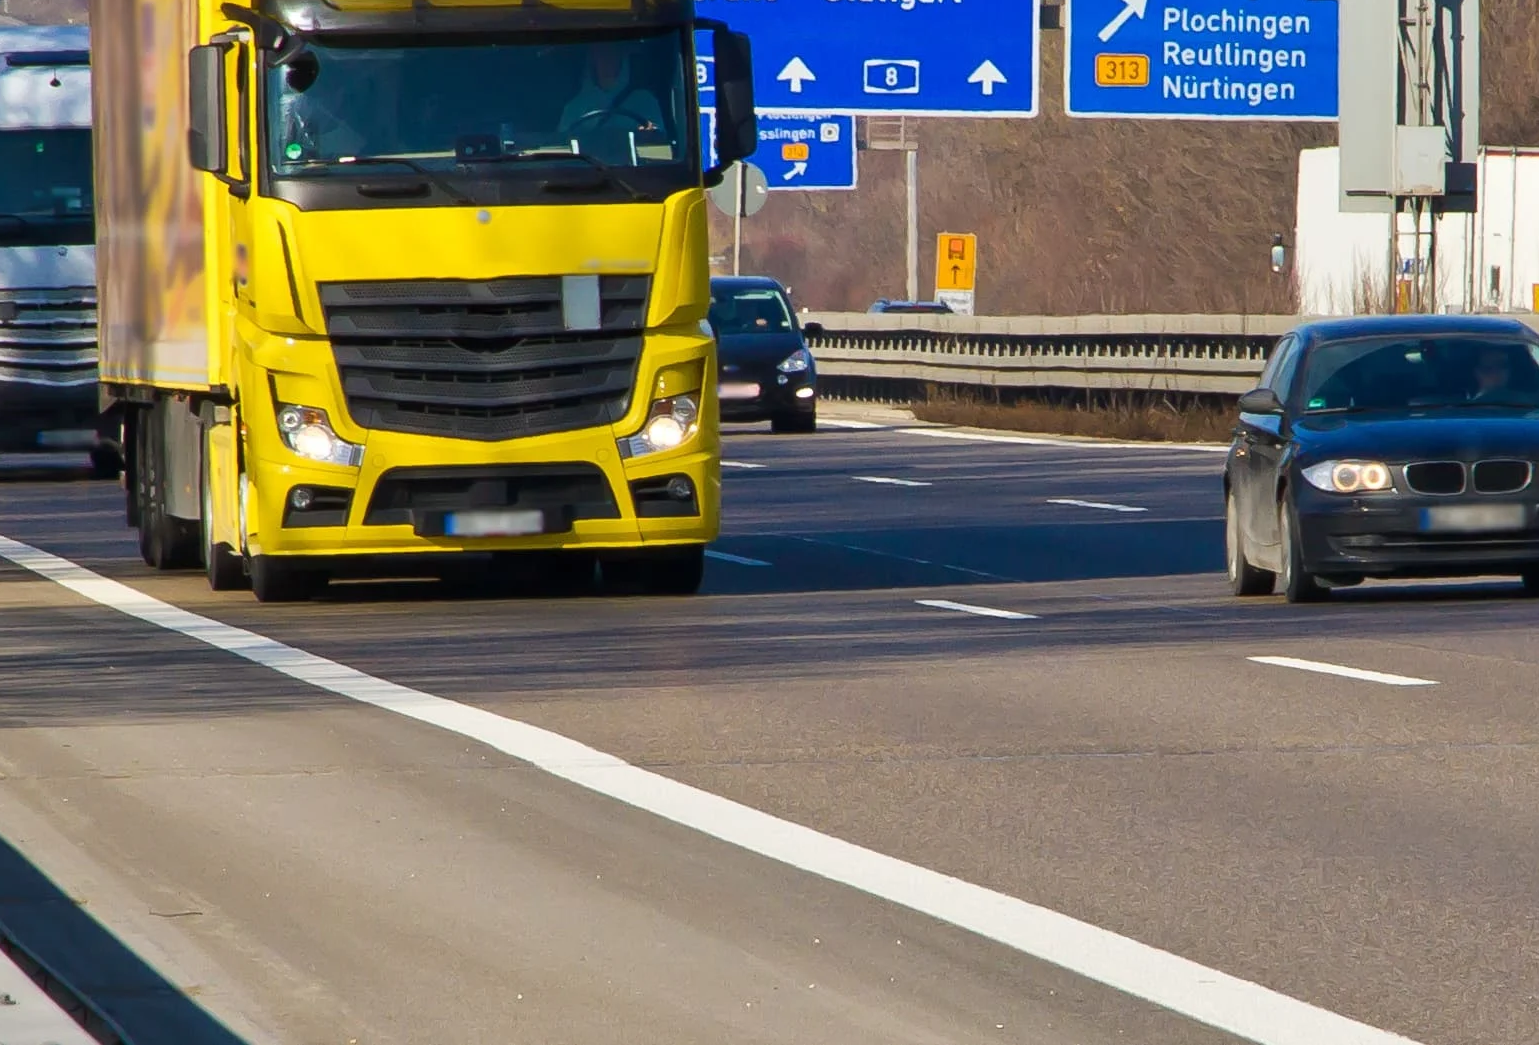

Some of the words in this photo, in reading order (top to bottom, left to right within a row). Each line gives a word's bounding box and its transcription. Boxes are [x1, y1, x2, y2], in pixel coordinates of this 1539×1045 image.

[1163, 7, 1310, 40] Plochingen
[1163, 41, 1306, 73] Reutlingen
[885, 66, 898, 86] 8
[1105, 60, 1140, 81] 313
[1162, 75, 1295, 106] Nürtingen
[759, 127, 816, 144] sslingen
